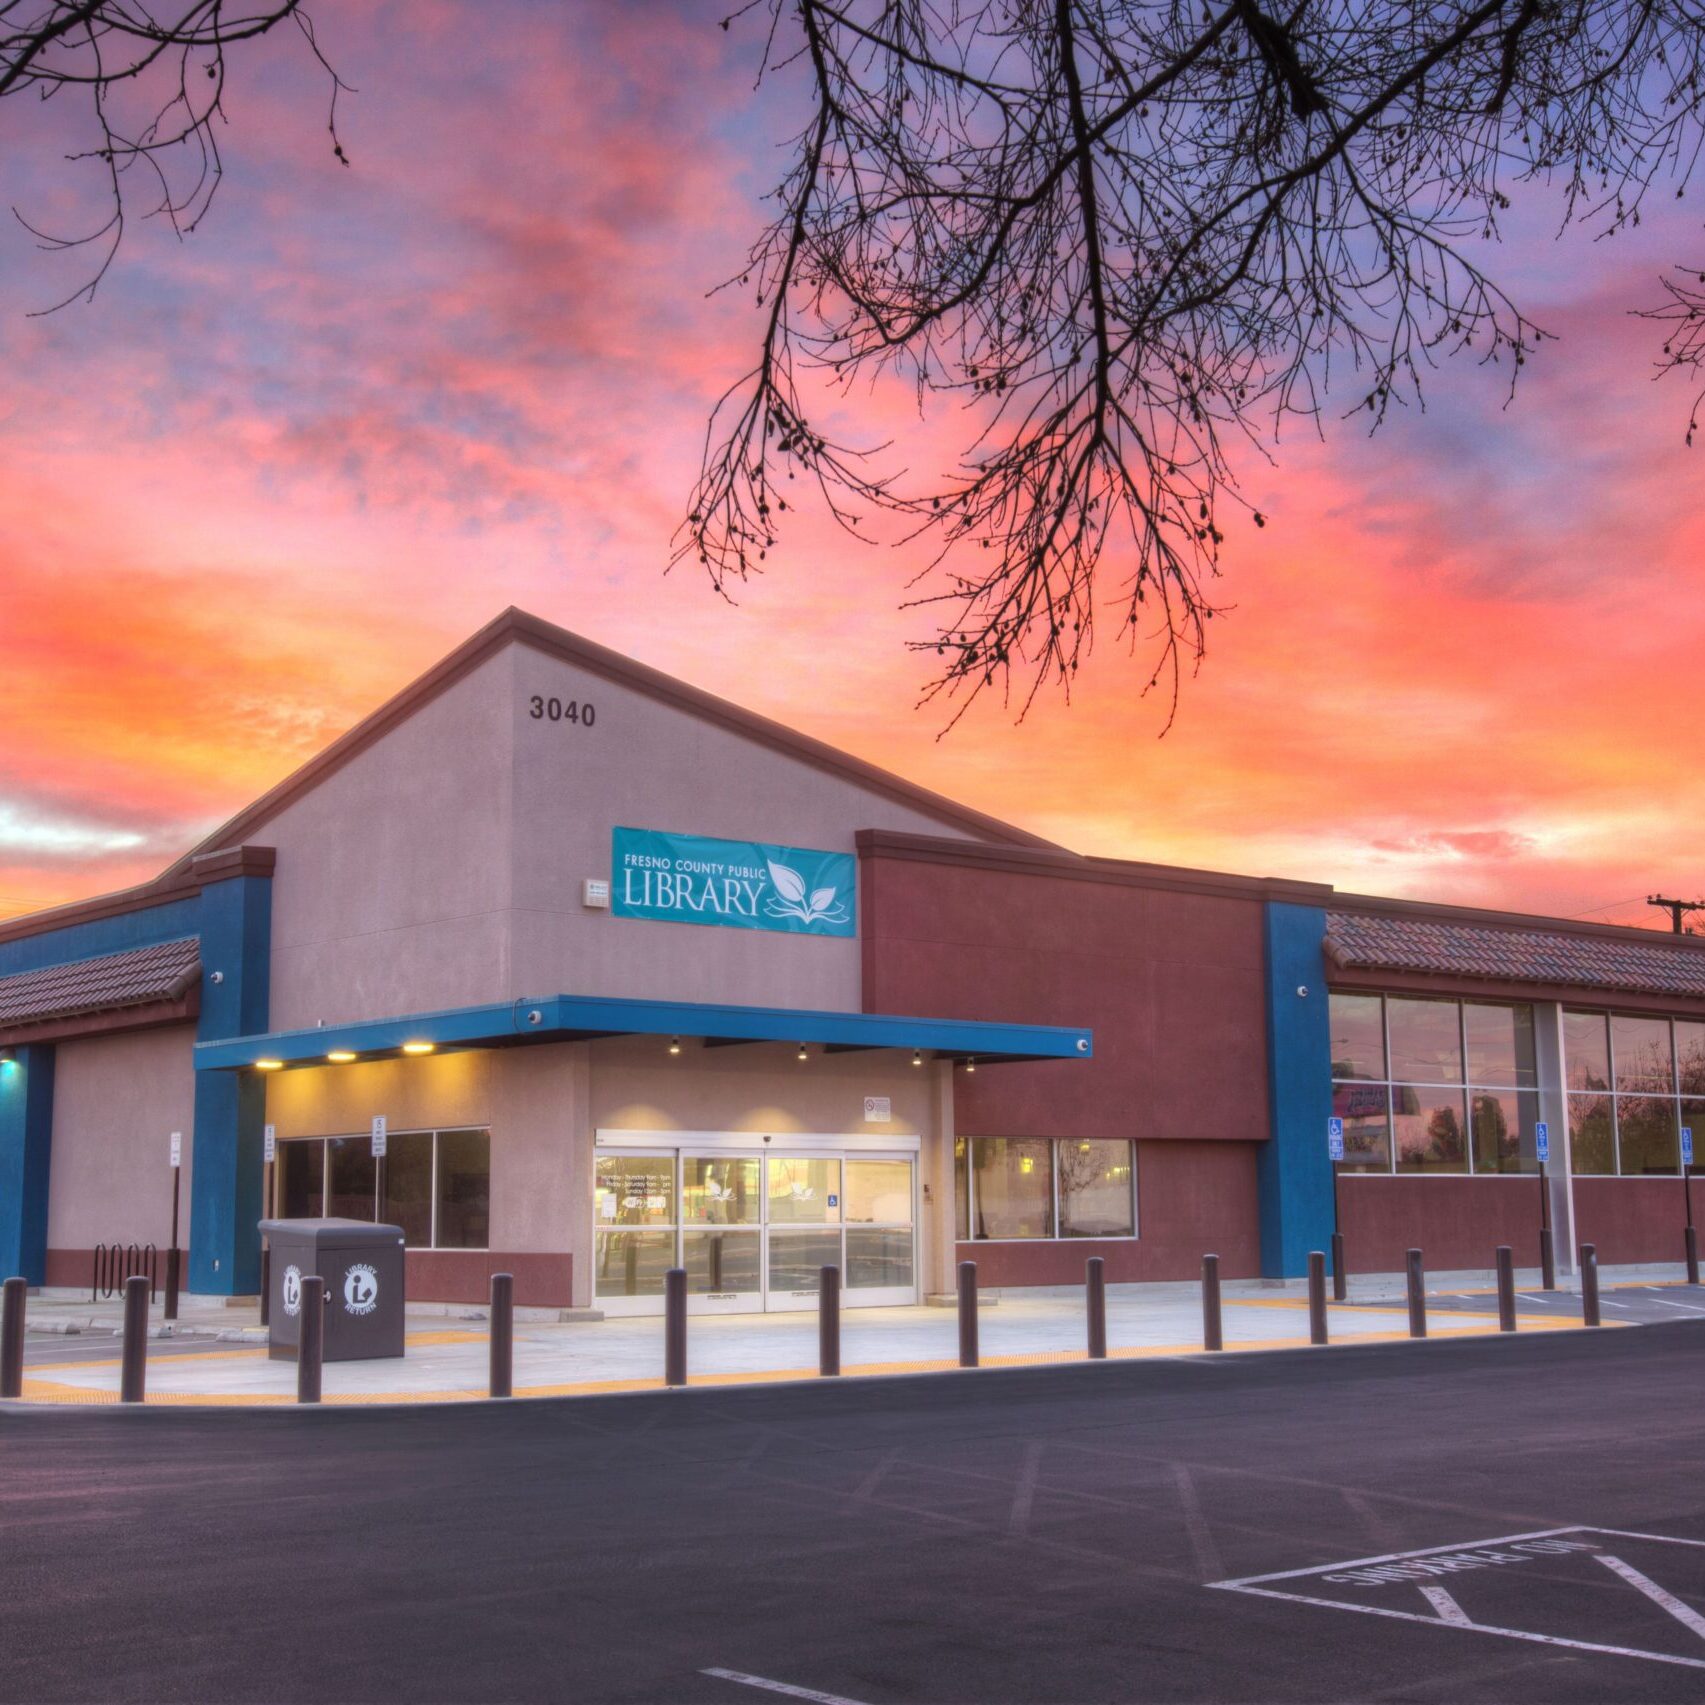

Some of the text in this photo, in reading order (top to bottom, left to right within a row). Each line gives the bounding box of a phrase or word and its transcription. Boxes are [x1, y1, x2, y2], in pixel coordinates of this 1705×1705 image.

[530, 695, 596, 727] 3040
[624, 853, 767, 880] FRESNO COUNTY PUBLIC
[624, 868, 765, 916] LIBRARY
[345, 1263, 378, 1278] LIBRARY
[344, 1303, 377, 1316] RETURN
[1321, 1539, 1602, 1586] NO PARKING
